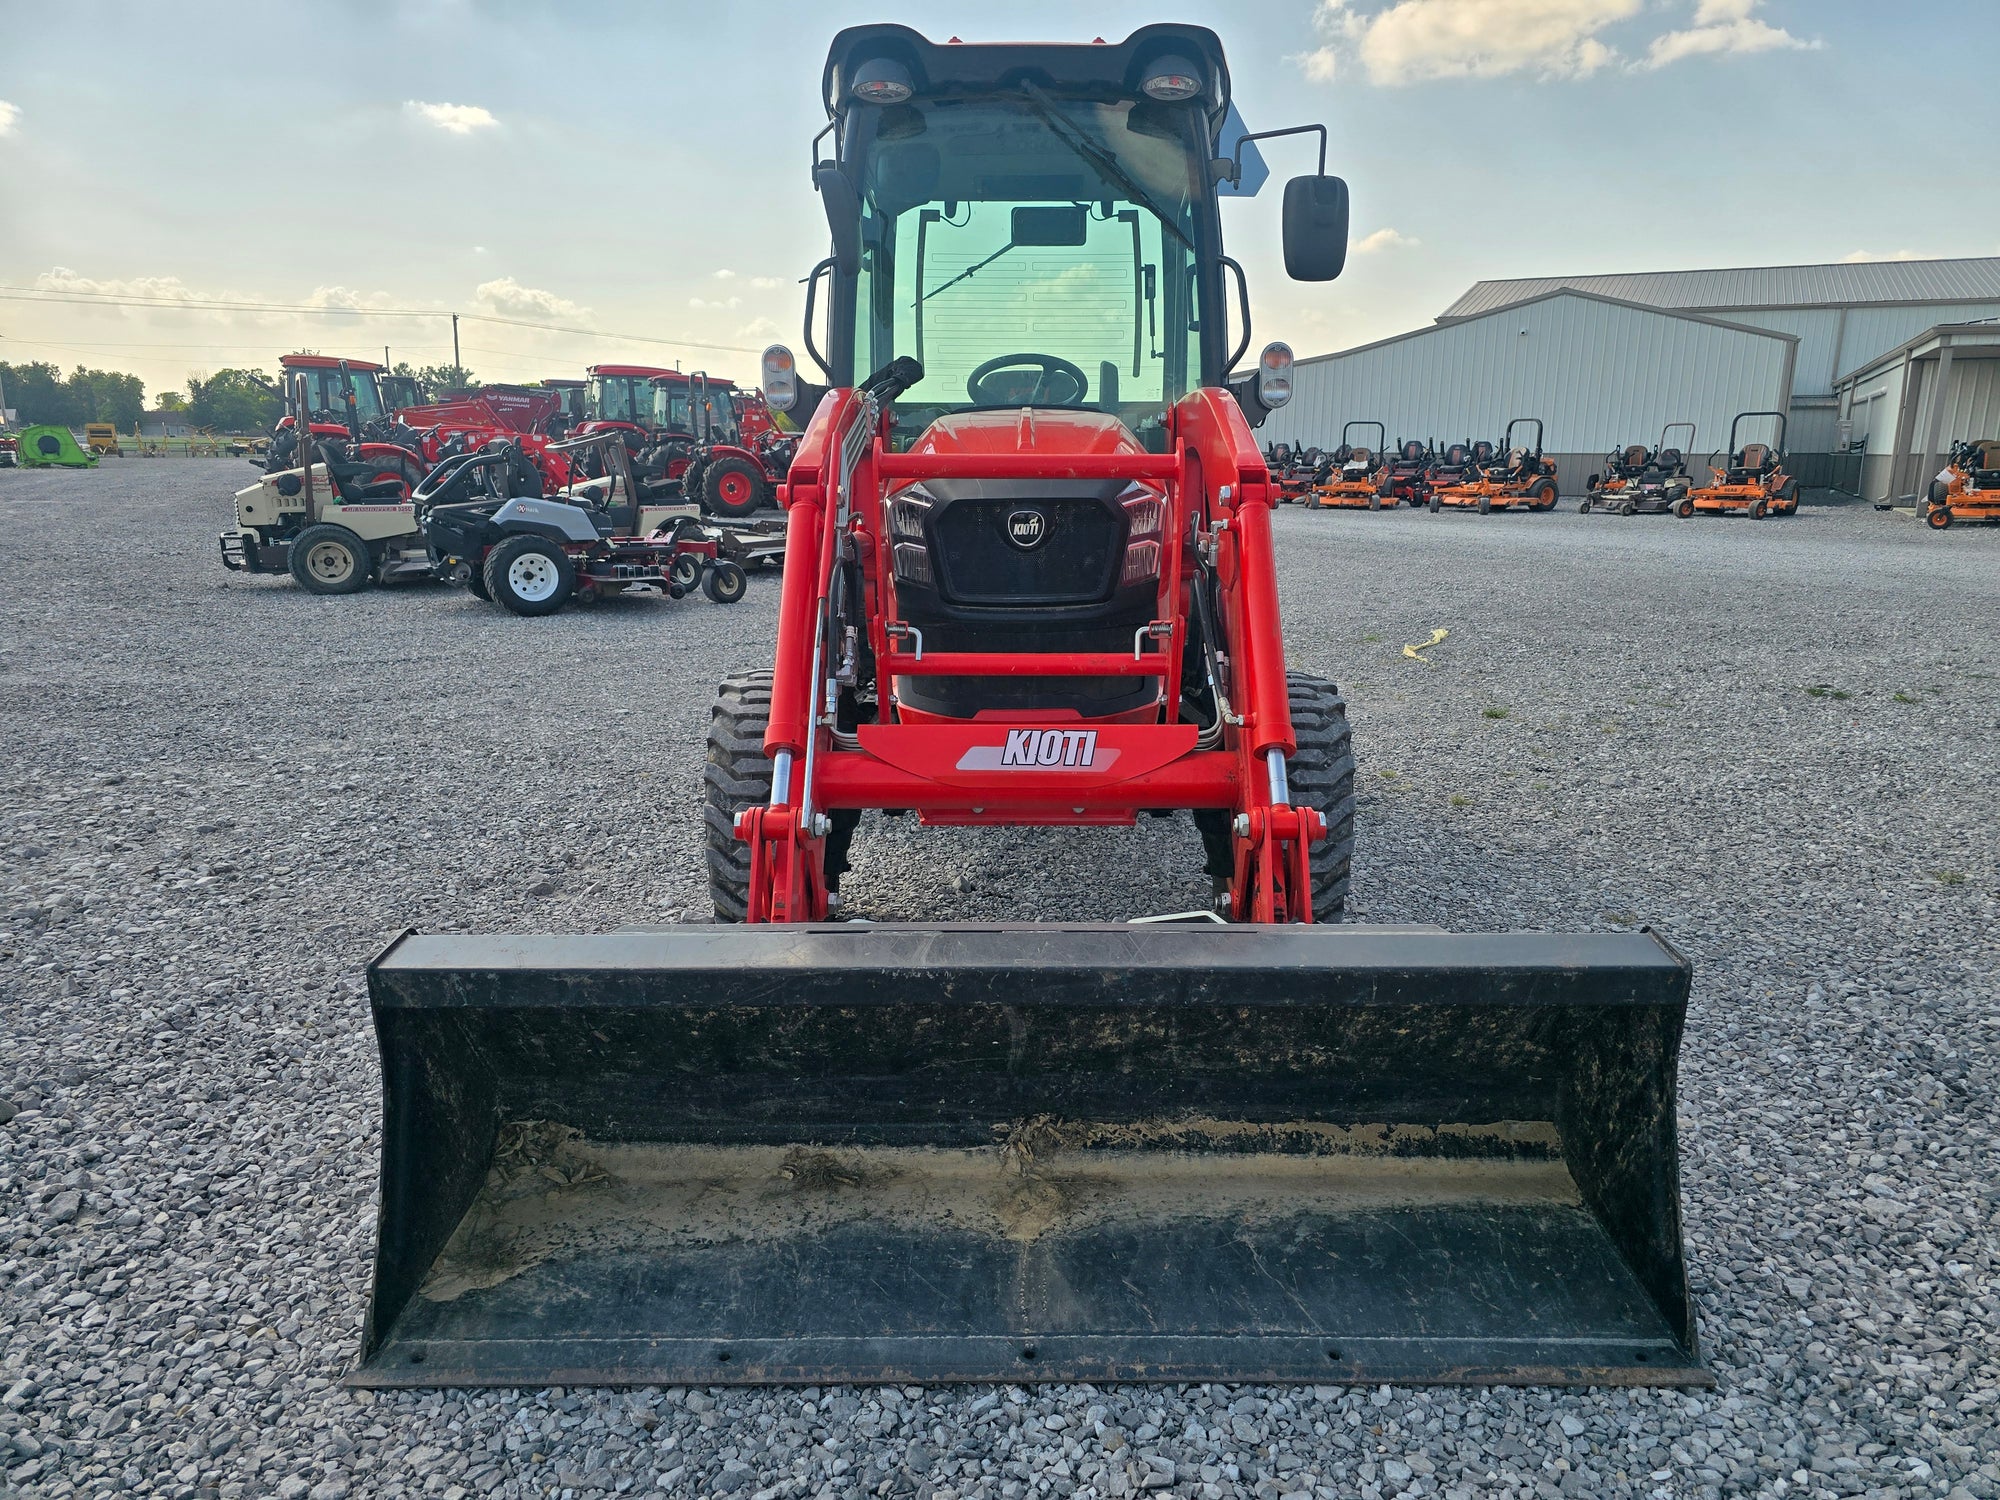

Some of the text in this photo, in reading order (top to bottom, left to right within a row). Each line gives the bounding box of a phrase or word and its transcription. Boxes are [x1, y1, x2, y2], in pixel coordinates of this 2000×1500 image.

[498, 395, 530, 403] YANMAR
[1013, 523, 1039, 535] KIOTI
[1001, 729, 1098, 767] KIOTI
